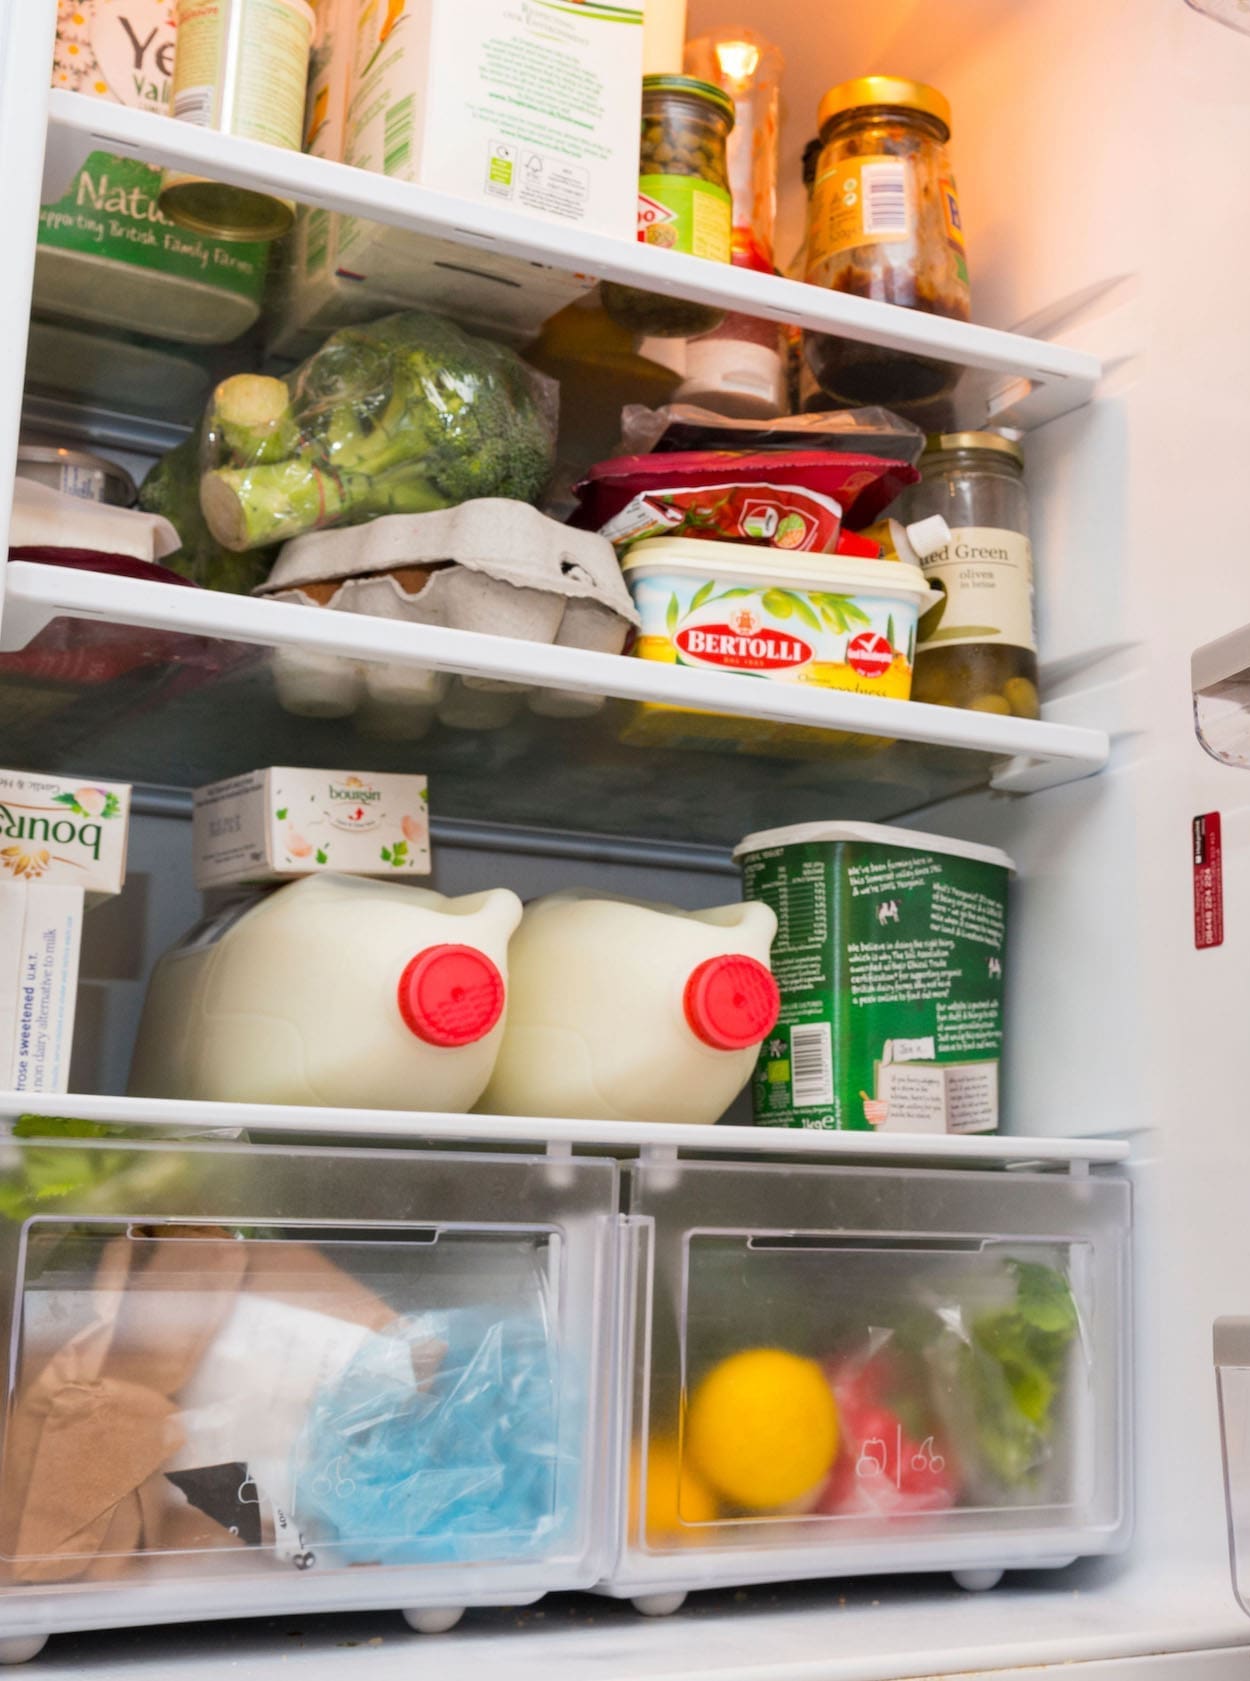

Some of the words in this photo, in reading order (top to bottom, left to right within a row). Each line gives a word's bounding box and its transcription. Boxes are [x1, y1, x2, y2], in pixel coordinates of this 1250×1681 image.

[76, 171, 175, 226] Natu
[109, 220, 157, 245] British
[163, 234, 211, 268] Family
[213, 246, 254, 275] Farms
[955, 544, 1009, 561] Green
[687, 630, 801, 661] BERTOLLI
[329, 785, 381, 805] boursin
[1204, 868, 1212, 887] 224
[43, 929, 56, 952] milk
[43, 955, 54, 967] to
[20, 987, 34, 1057] sweetened
[28, 952, 38, 981] U.H.T.
[39, 968, 53, 1030] alternative
[35, 1031, 49, 1063] dairy
